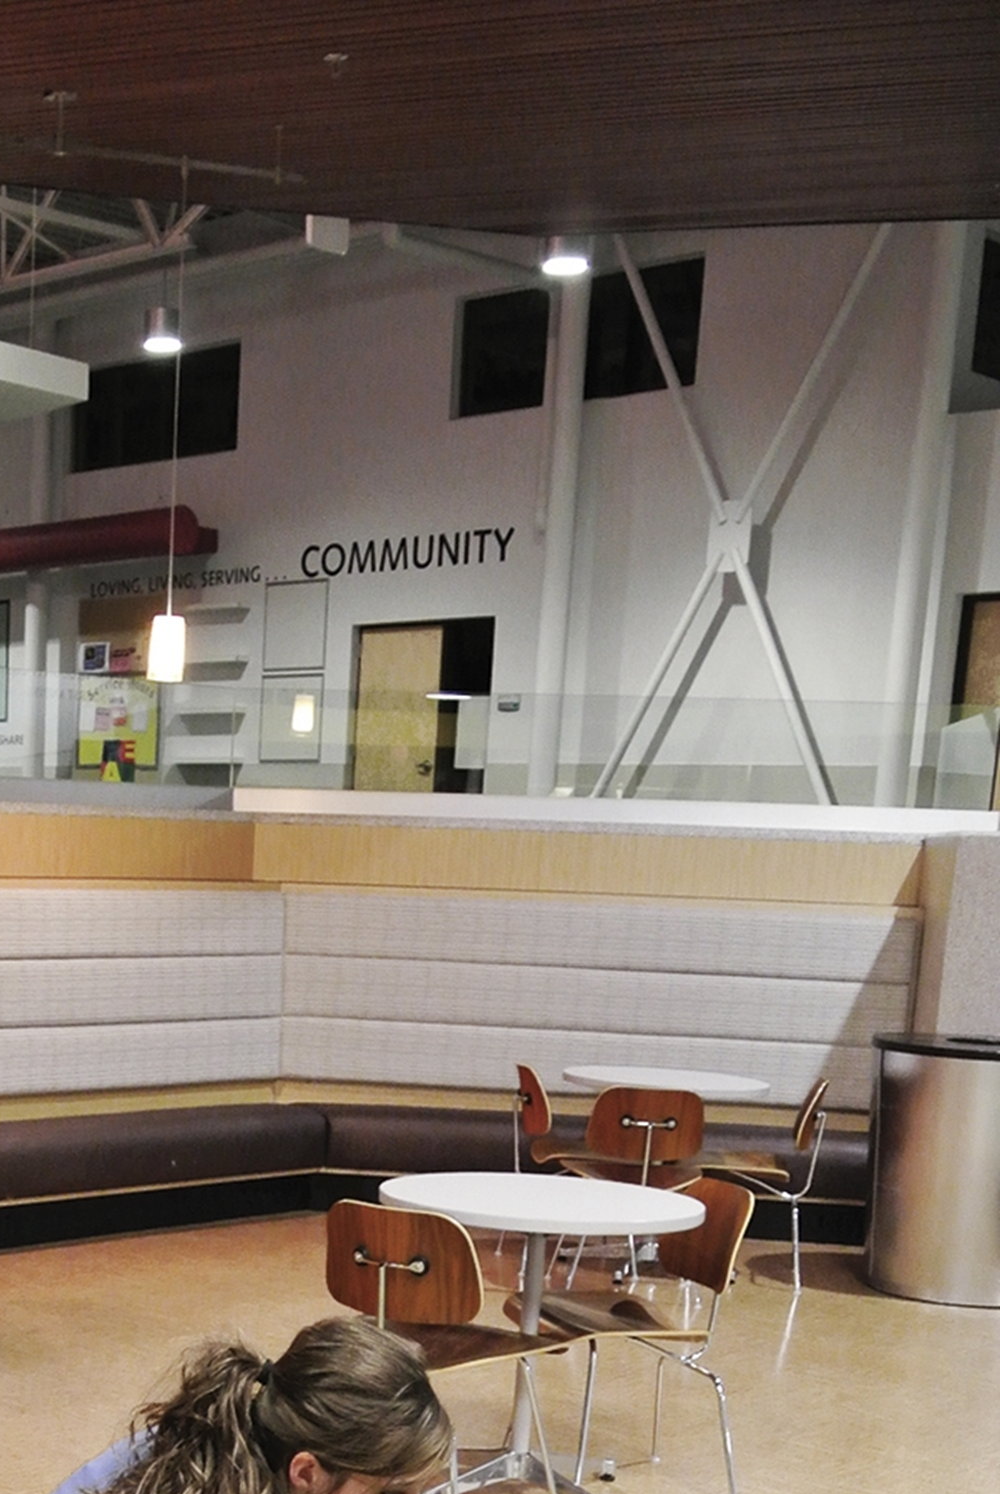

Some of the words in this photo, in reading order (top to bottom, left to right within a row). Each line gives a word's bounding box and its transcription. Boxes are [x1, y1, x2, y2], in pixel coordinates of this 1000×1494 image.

[90, 577, 144, 598] LOVING,
[148, 572, 196, 592] LIVNG,
[301, 527, 515, 578] COMMUNITY
